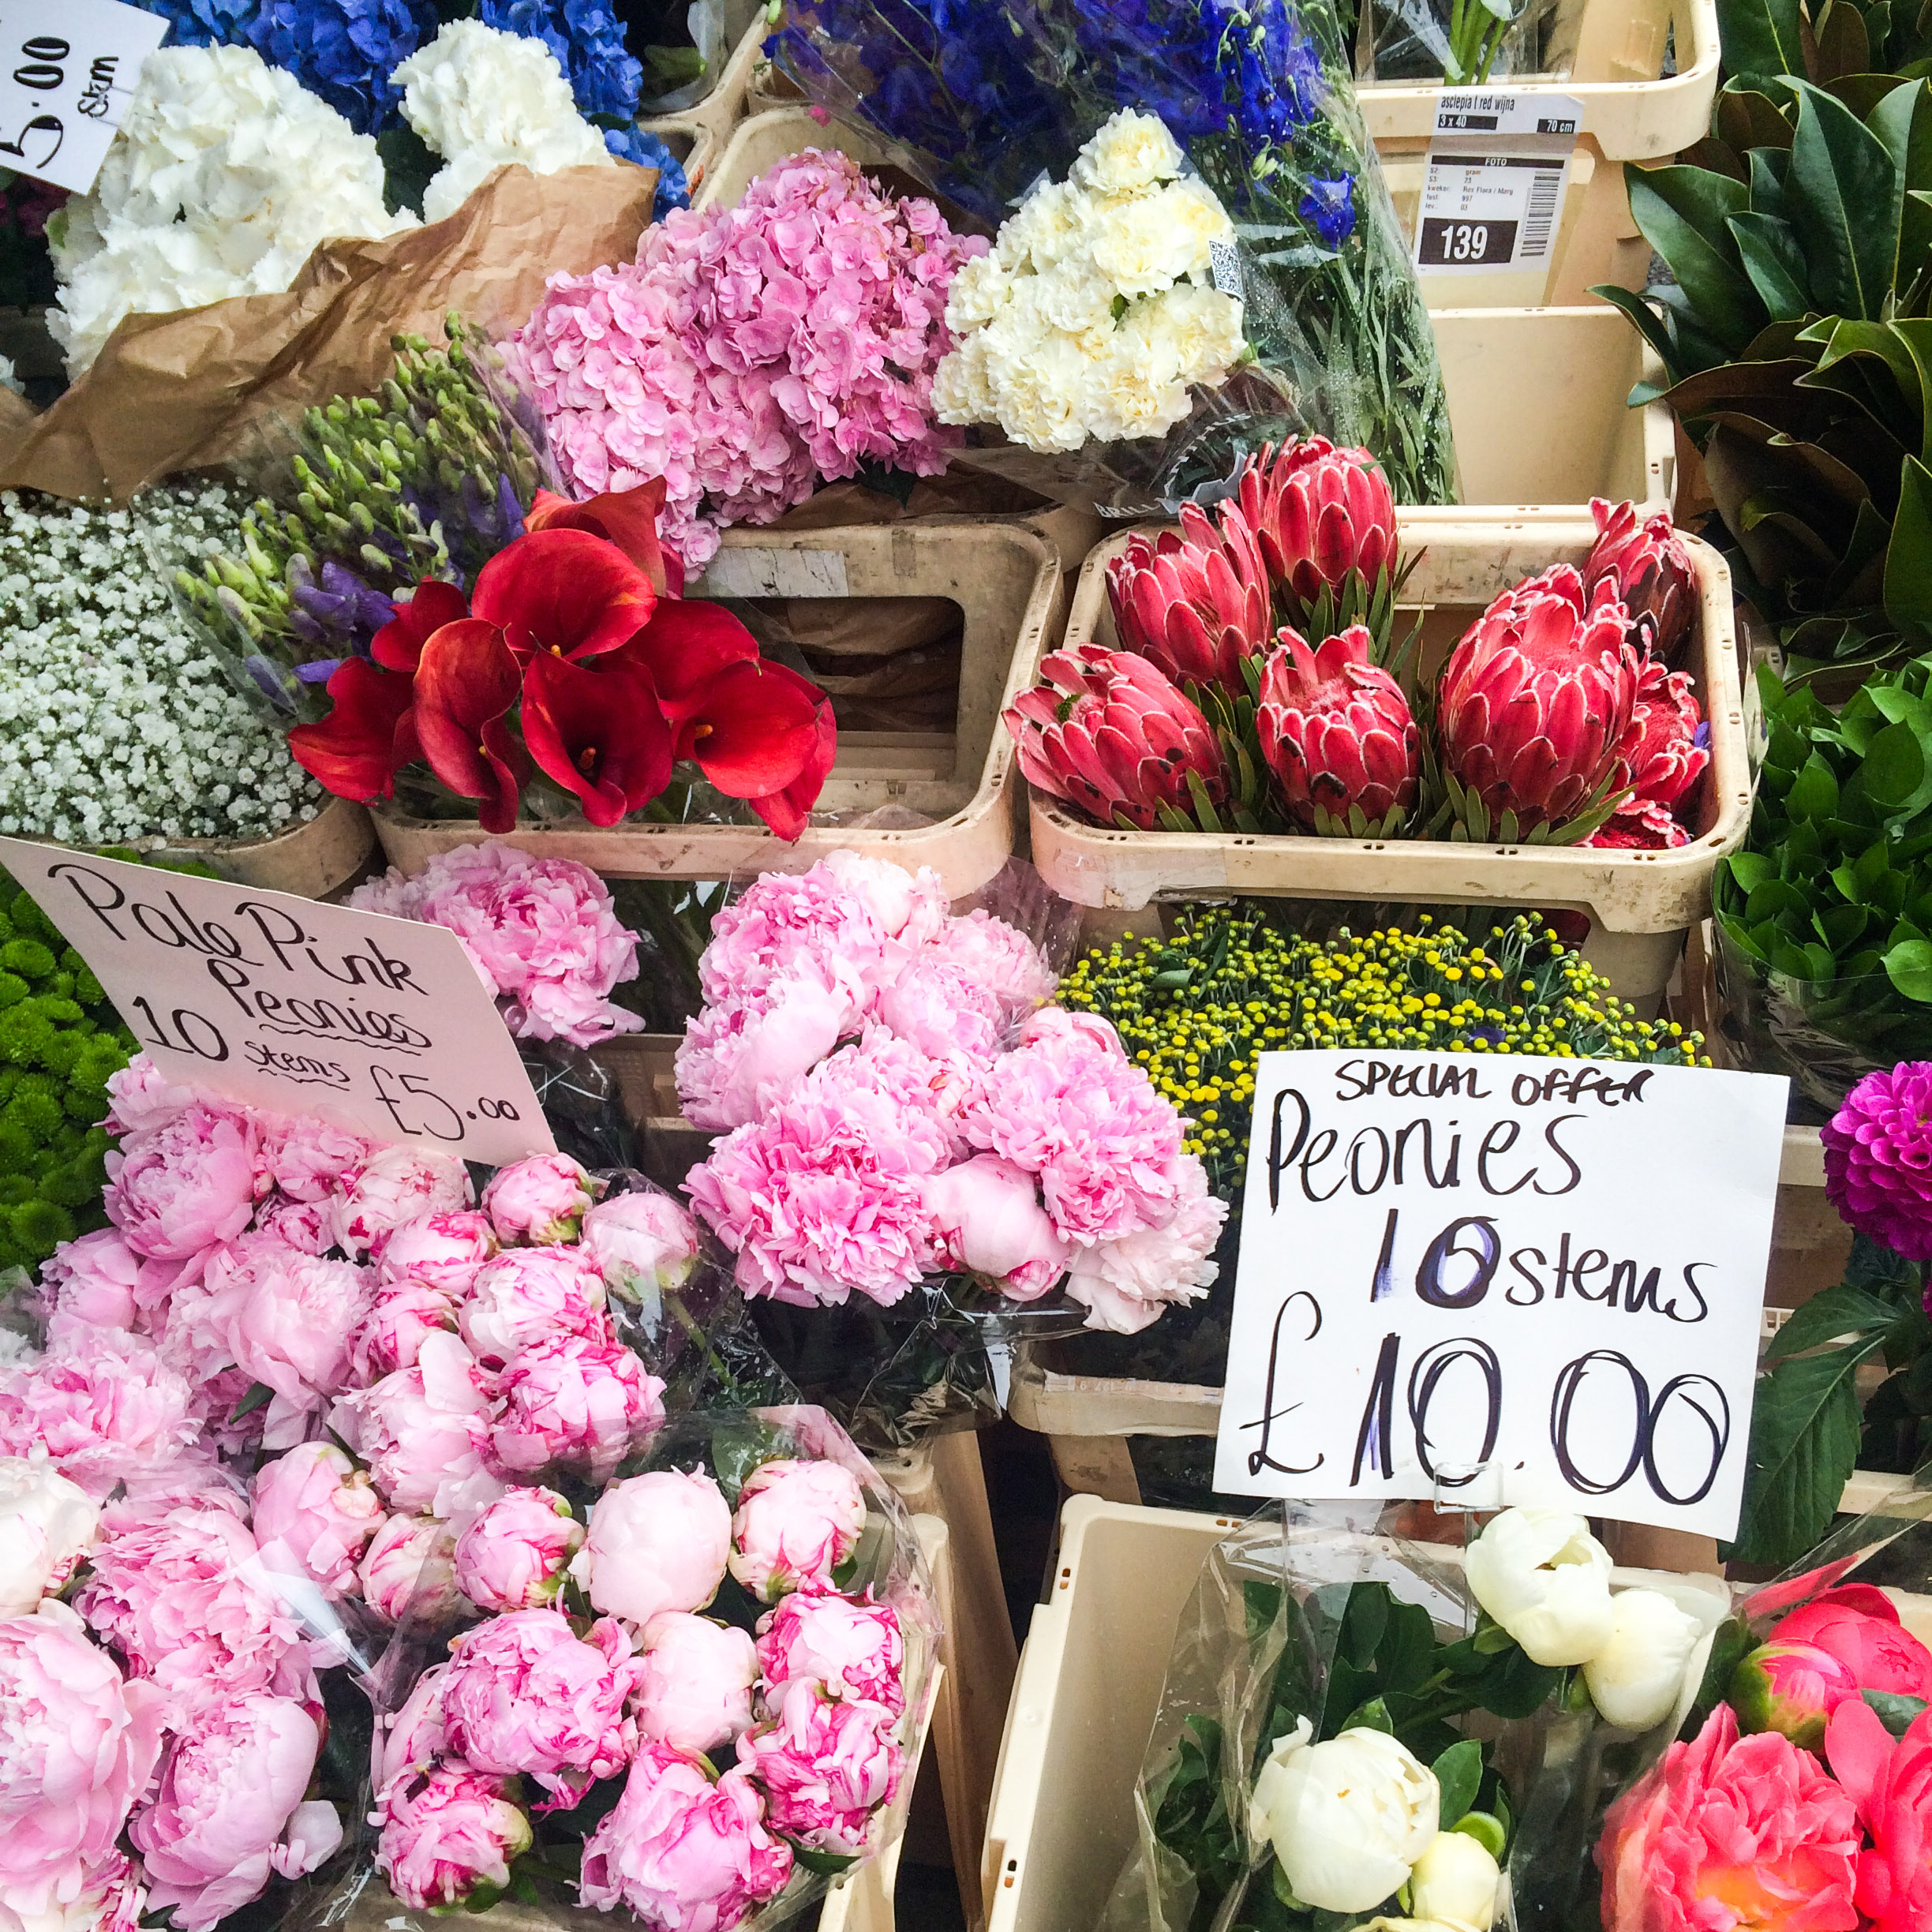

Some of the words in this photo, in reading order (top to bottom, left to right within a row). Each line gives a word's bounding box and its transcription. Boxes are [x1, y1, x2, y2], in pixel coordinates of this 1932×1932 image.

[1440, 115, 1446, 126] 3
[1447, 118, 1454, 126] x
[1455, 115, 1466, 127] 40
[1441, 95, 1472, 111] asclepia
[1479, 95, 1492, 110] red
[1546, 119, 1557, 132] 70
[1559, 122, 1573, 133] cm
[1485, 157, 1507, 167] FOTO
[1441, 225, 1488, 260] 139
[47, 863, 263, 966] Pale
[234, 901, 429, 996] Pink
[132, 994, 230, 1062] 10
[207, 957, 432, 1049] Peonies
[369, 1065, 521, 1142] £5.00
[1265, 1088, 1590, 1216] Peonies
